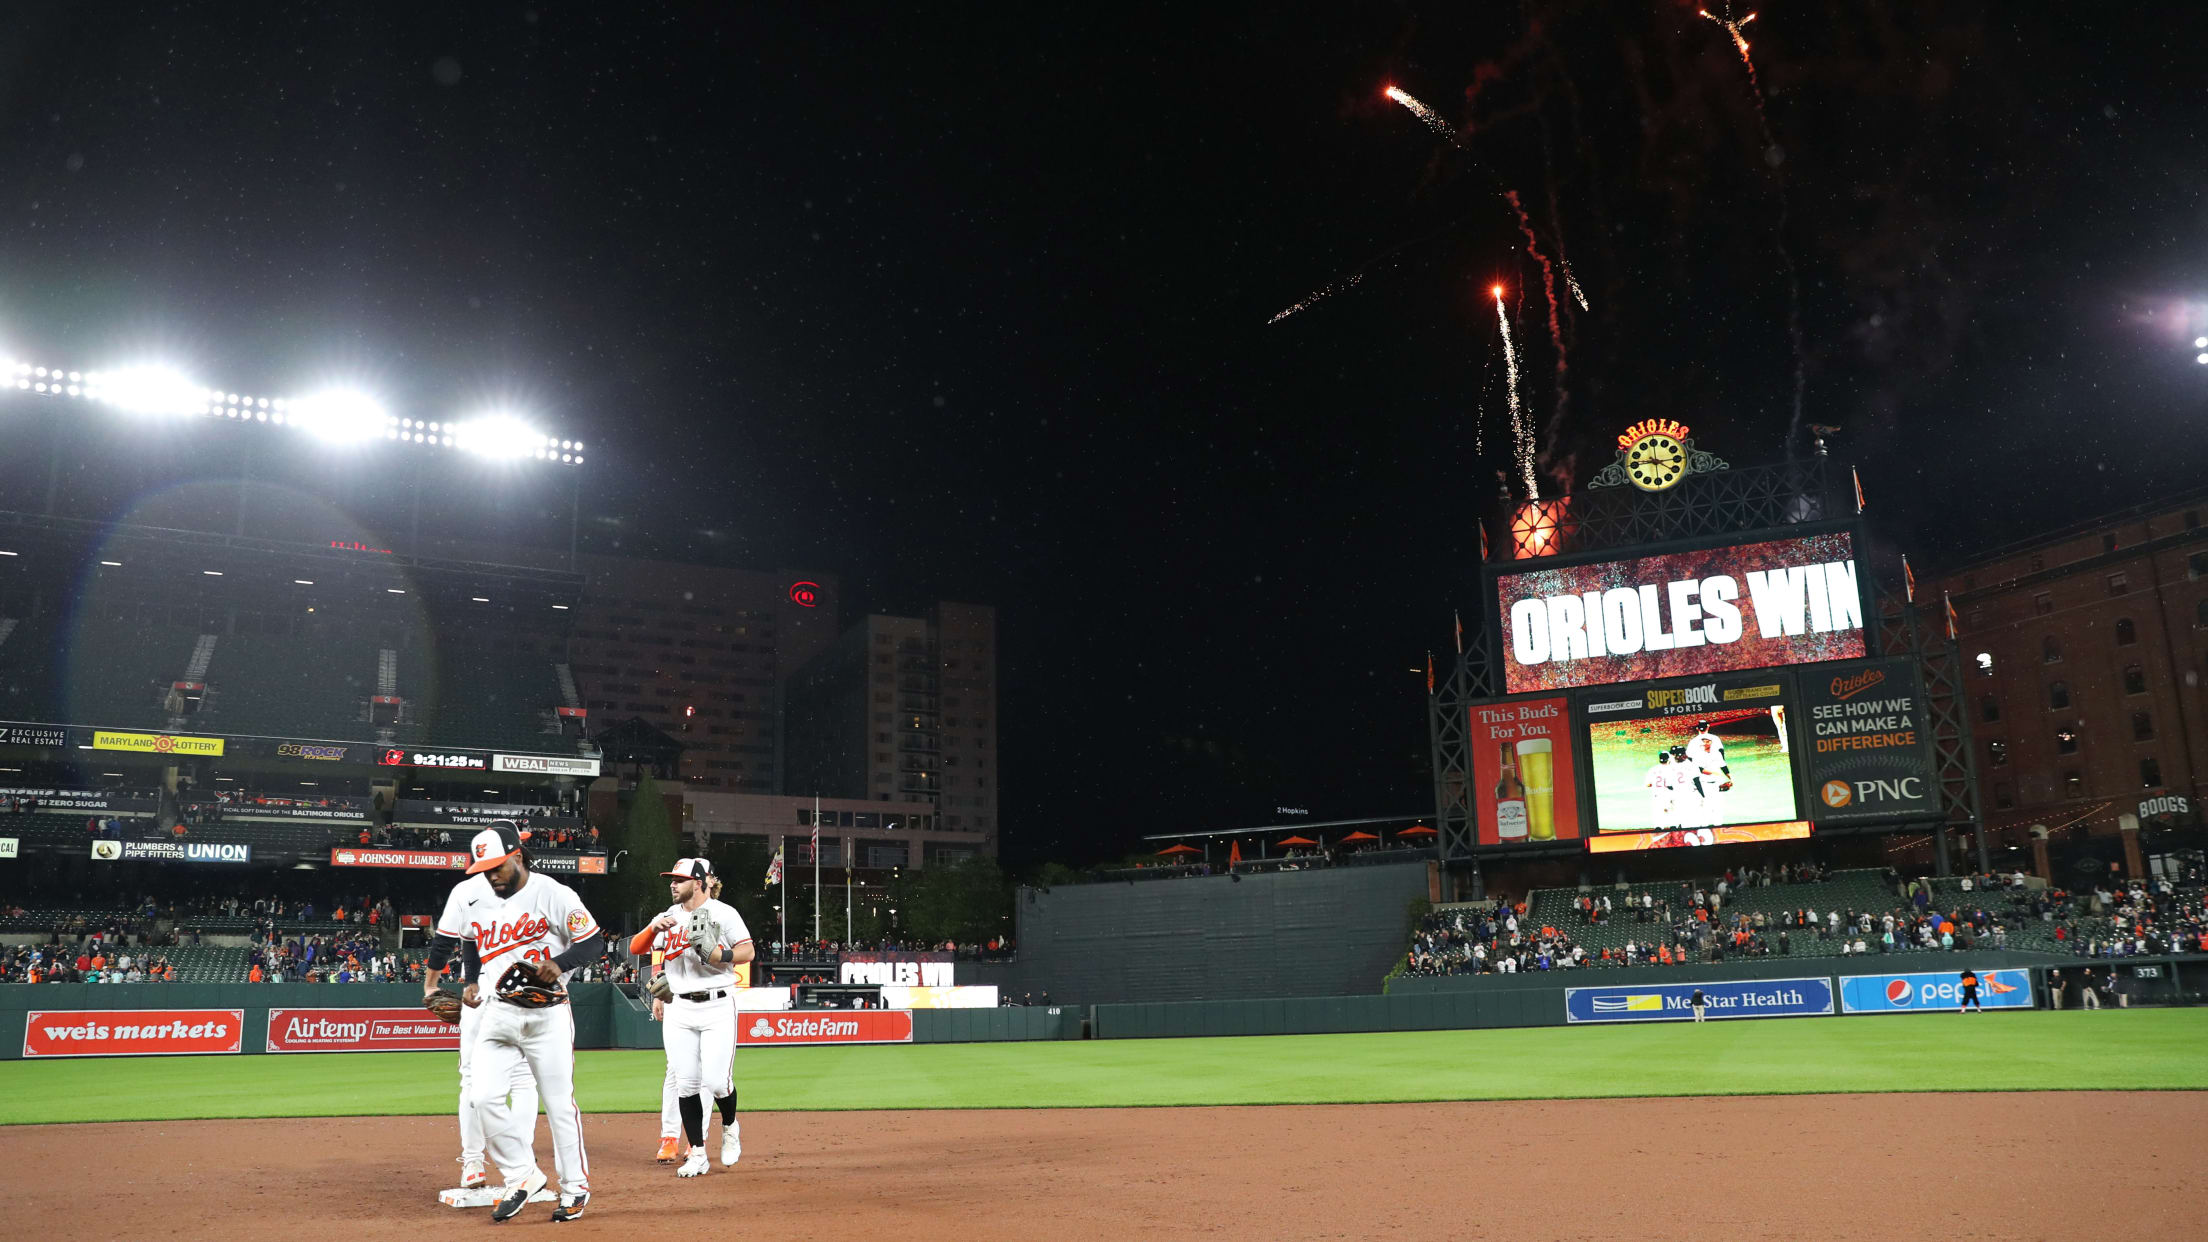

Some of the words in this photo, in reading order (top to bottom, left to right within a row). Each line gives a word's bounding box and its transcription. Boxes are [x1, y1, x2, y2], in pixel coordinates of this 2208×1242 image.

[1617, 418, 1689, 449] ORIOLES
[1510, 574, 1742, 666] ORIOLES
[1746, 560, 1863, 639] WIN
[1830, 669, 1885, 697] Orioles
[1647, 684, 1719, 709] SUPERBOOK
[1590, 702, 1642, 711] SUPERBOOK.COM
[1664, 704, 1703, 714] SPORTS
[1813, 704, 1843, 719] SEE
[1846, 700, 1883, 716] HOW
[1885, 698, 1912, 712] WE
[1479, 709, 1515, 724] This
[1519, 704, 1559, 720] Bud's
[1490, 725, 1515, 739] For
[1518, 722, 1551, 737] You.
[1816, 721, 1848, 736] CAN
[1851, 716, 1897, 733] MAKE
[1900, 715, 1912, 728] A
[12, 729, 65, 738] EXCLUSIVE
[100, 736, 153, 747] MARYLAND
[176, 741, 217, 750] LOTTERY
[1816, 731, 1916, 752] DIFFERENCE
[413, 754, 467, 767] 9:21:25
[469, 759, 483, 767] PM
[504, 758, 547, 770] WBAL
[1854, 777, 1923, 802] PNC
[75, 800, 107, 808] SUGAR
[292, 809, 332, 817] BALTIMORE
[334, 811, 364, 819] ORIOLES
[126, 842, 175, 851] PLUMBERS
[188, 843, 247, 860] UNION
[125, 850, 146, 858] PIPE
[148, 851, 185, 859] FITTERS
[359, 853, 406, 865] JOHNSON
[409, 855, 446, 865] LUMBER
[2137, 968, 2158, 978] 373
[1666, 994, 1738, 1009] MeStar
[1741, 989, 1804, 1006] Health
[1047, 1007, 1060, 1015] 410
[44, 1022, 109, 1040] weis
[114, 1020, 227, 1040] markets
[285, 1017, 367, 1041] Airtemp
[375, 1026, 391, 1034] The
[393, 1025, 411, 1034] Best
[414, 1025, 436, 1034] Value
[439, 1025, 447, 1034] in
